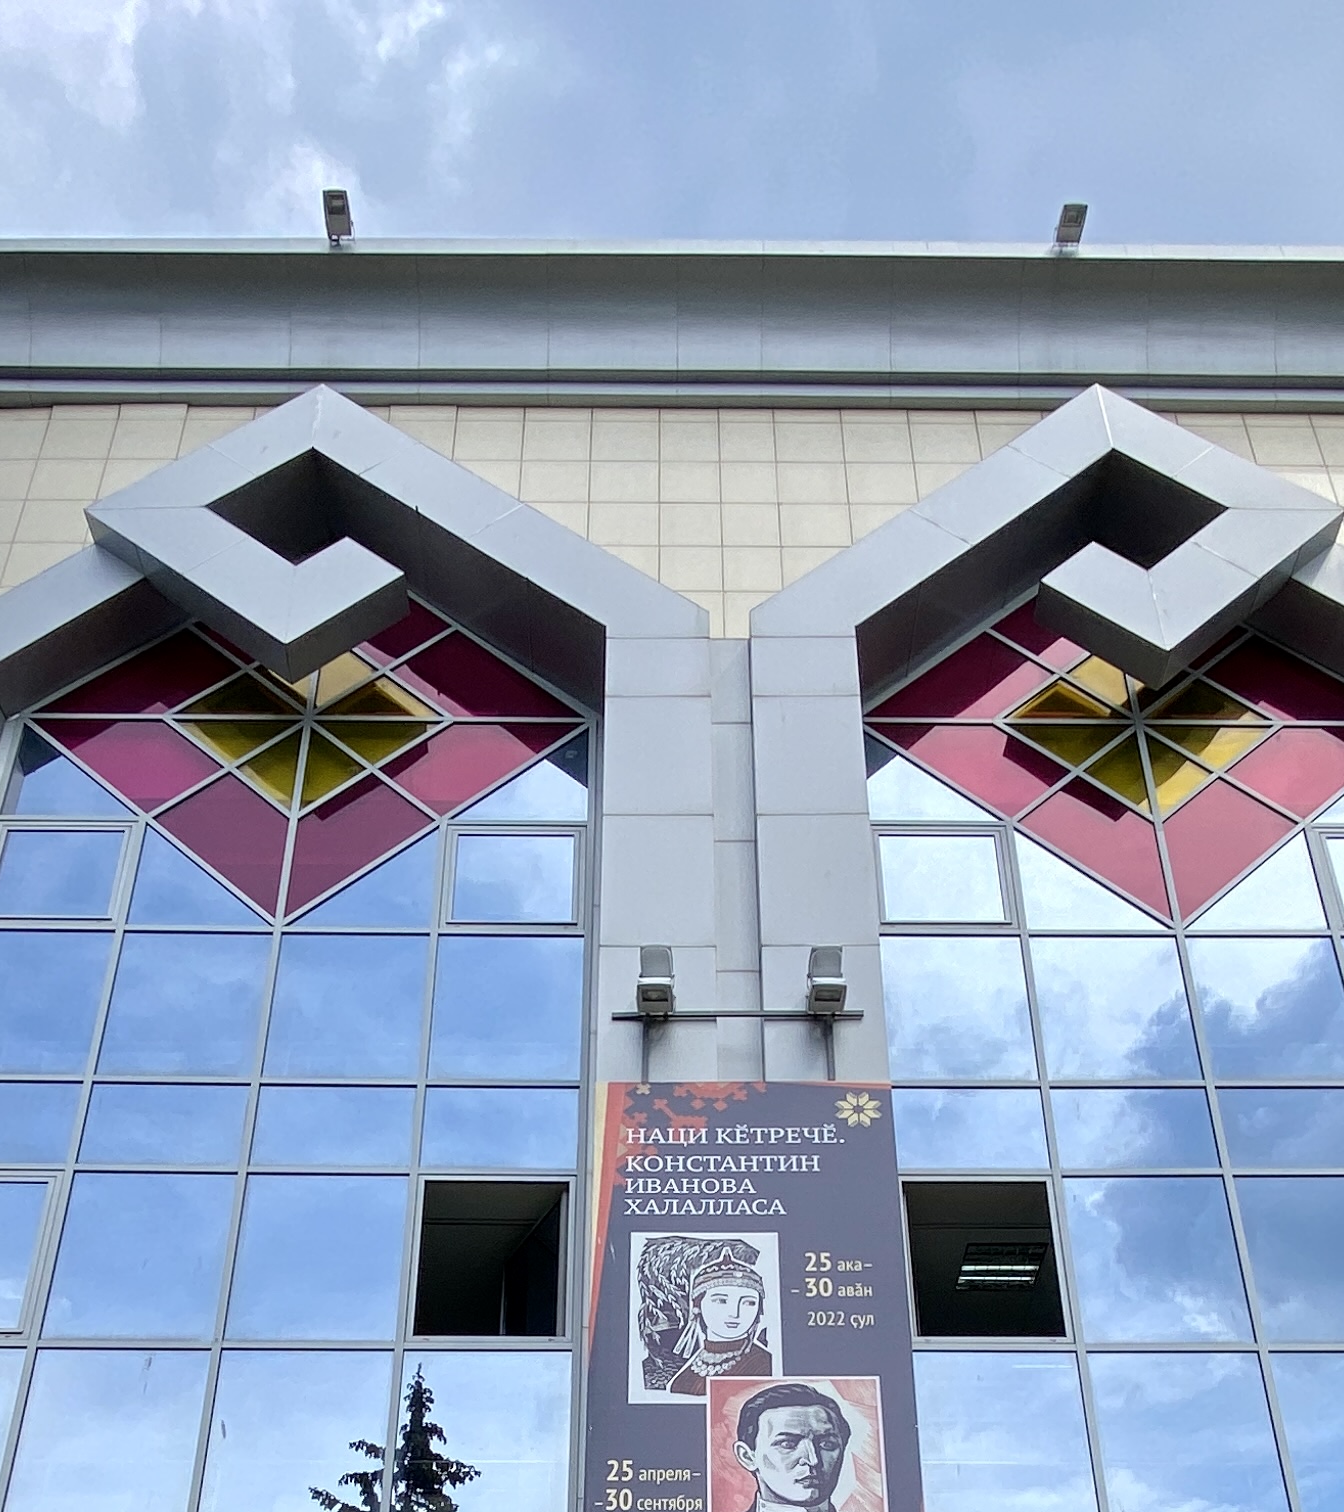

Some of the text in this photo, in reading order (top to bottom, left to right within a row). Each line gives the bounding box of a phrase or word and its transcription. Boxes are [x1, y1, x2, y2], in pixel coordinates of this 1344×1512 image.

[626, 1127, 708, 1147] НАЦИ
[625, 1155, 820, 1172] КОНСТАНТИН
[624, 1178, 757, 1194] ИВАНОВА
[623, 1199, 787, 1215] ХАЛАЛЛАСА
[804, 1252, 832, 1272] 25
[807, 1311, 846, 1326] 2022
[606, 1459, 634, 1481] 25
